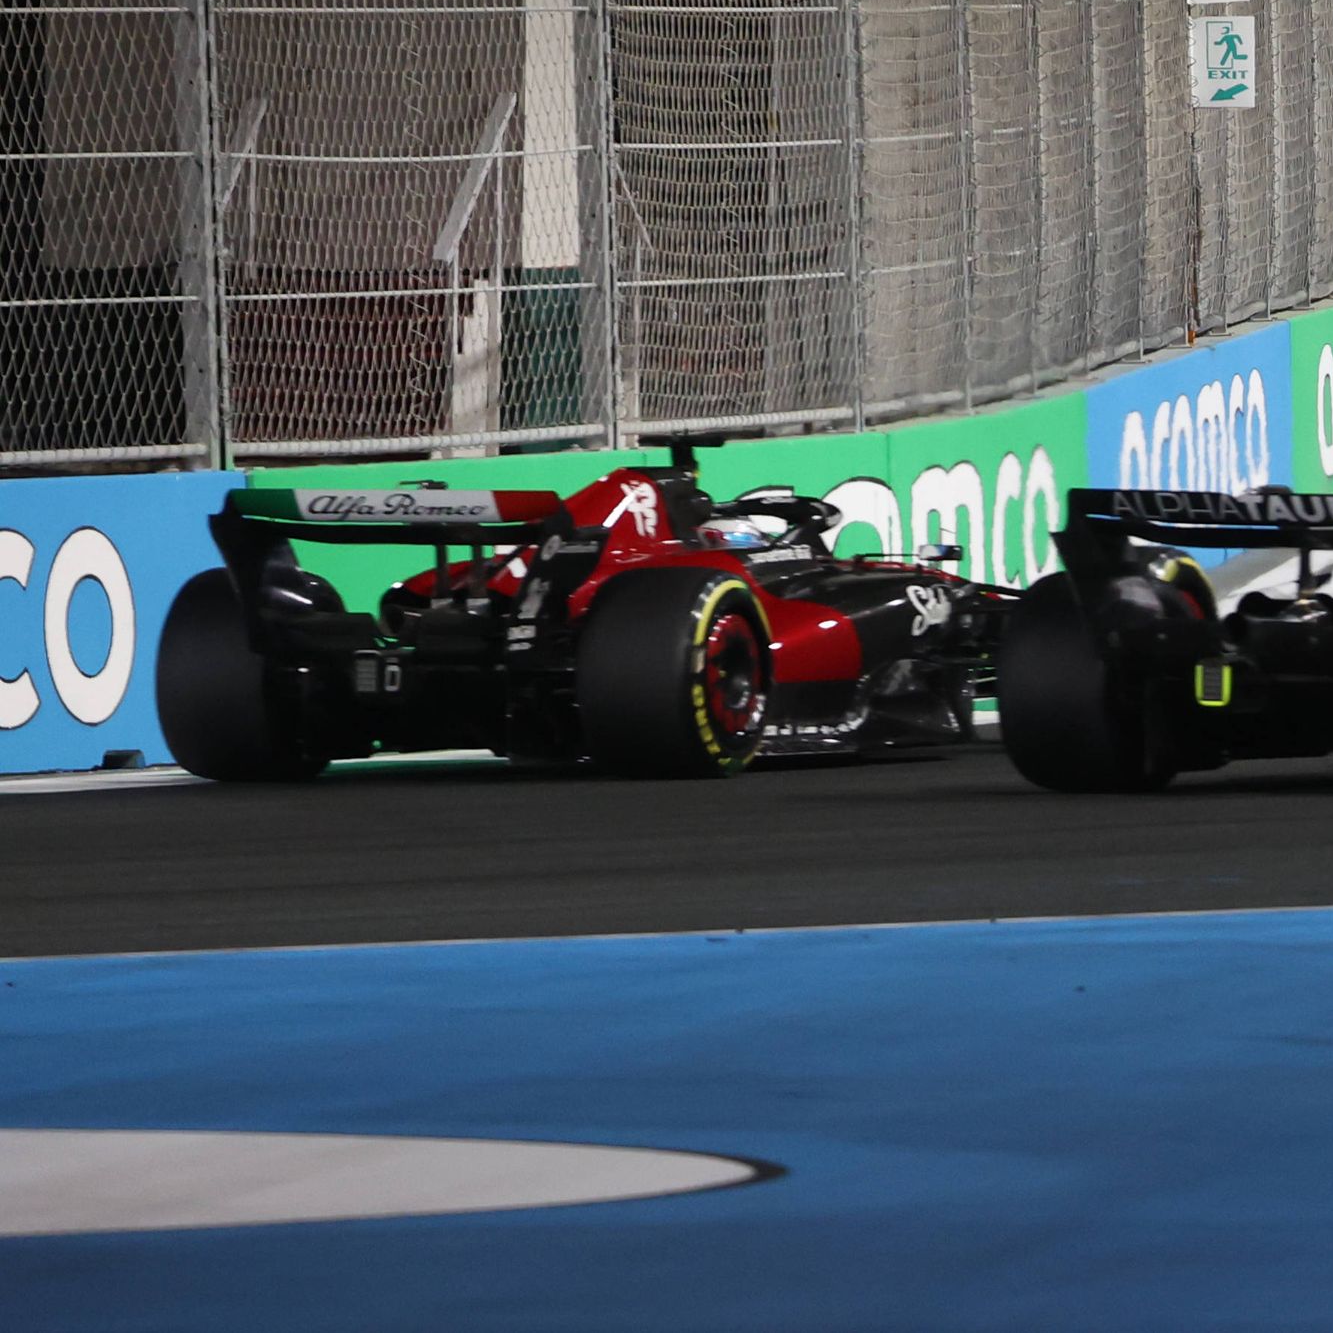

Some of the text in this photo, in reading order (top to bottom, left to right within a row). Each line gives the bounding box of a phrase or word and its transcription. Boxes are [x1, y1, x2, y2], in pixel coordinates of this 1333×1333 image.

[1207, 70, 1249, 80] EXIT
[1120, 368, 1270, 496] aramco
[307, 493, 488, 520] Alfa Romeo
[819, 444, 1061, 591] amco
